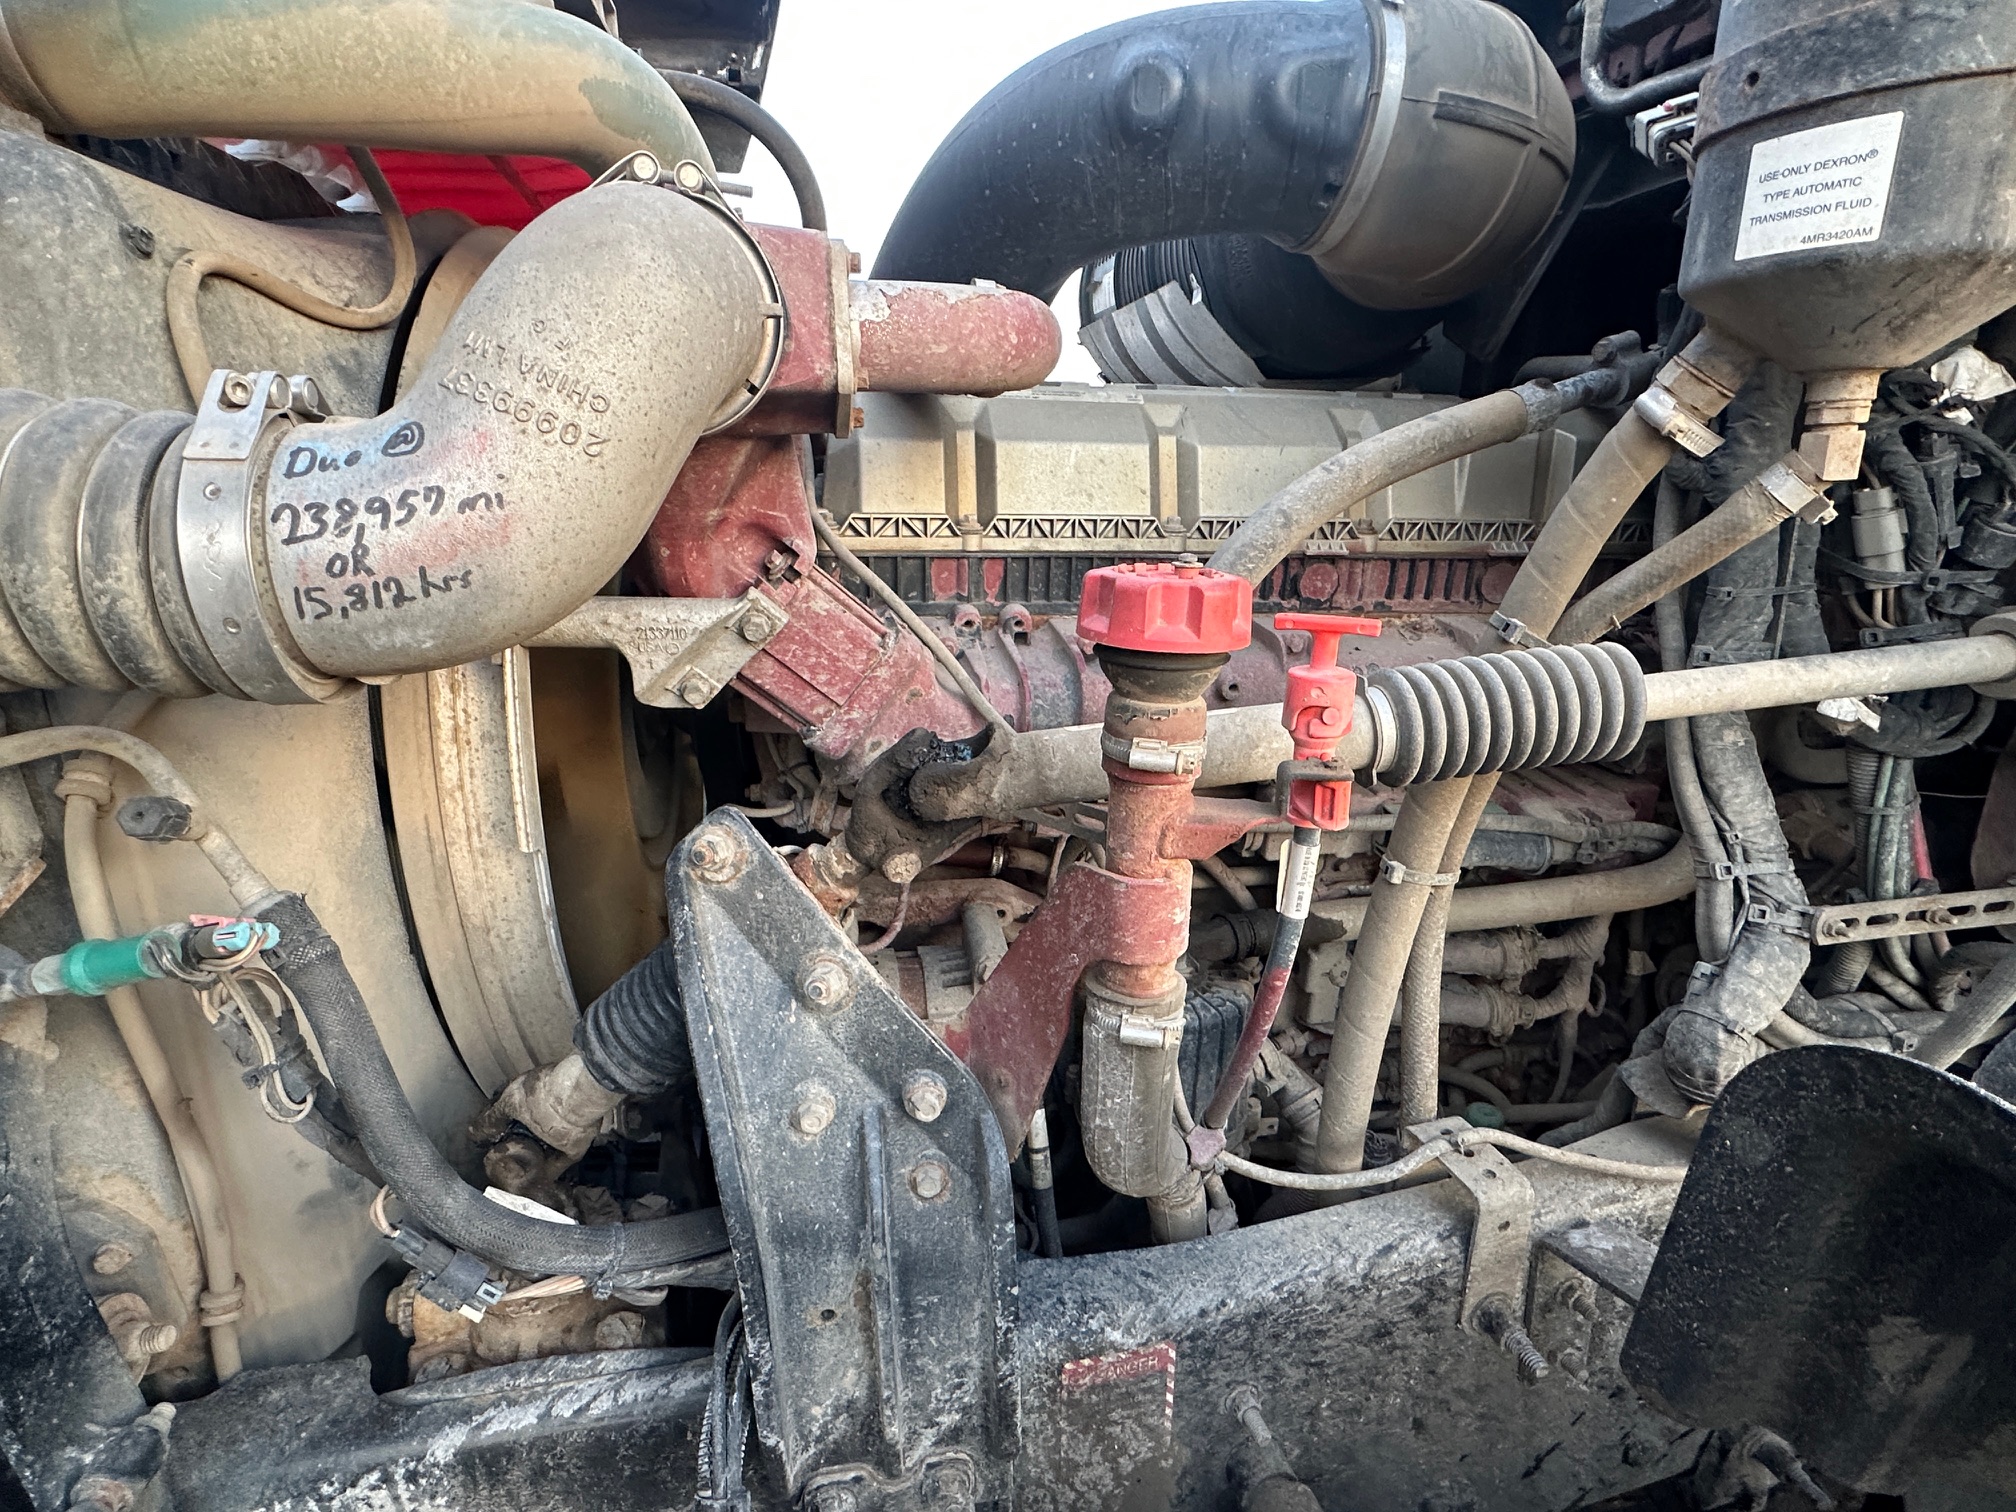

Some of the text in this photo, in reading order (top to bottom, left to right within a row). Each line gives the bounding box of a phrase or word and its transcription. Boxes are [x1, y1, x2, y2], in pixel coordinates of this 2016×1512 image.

[1763, 176, 1863, 203] TYPE AUTOMATIC
[1750, 197, 1873, 227] TRANSMISSION FLUID
[1799, 226, 1874, 245] 4MR3420AM
[519, 353, 611, 413] CHINA
[437, 365, 612, 458] 20999337
[293, 576, 417, 620] 15,812
